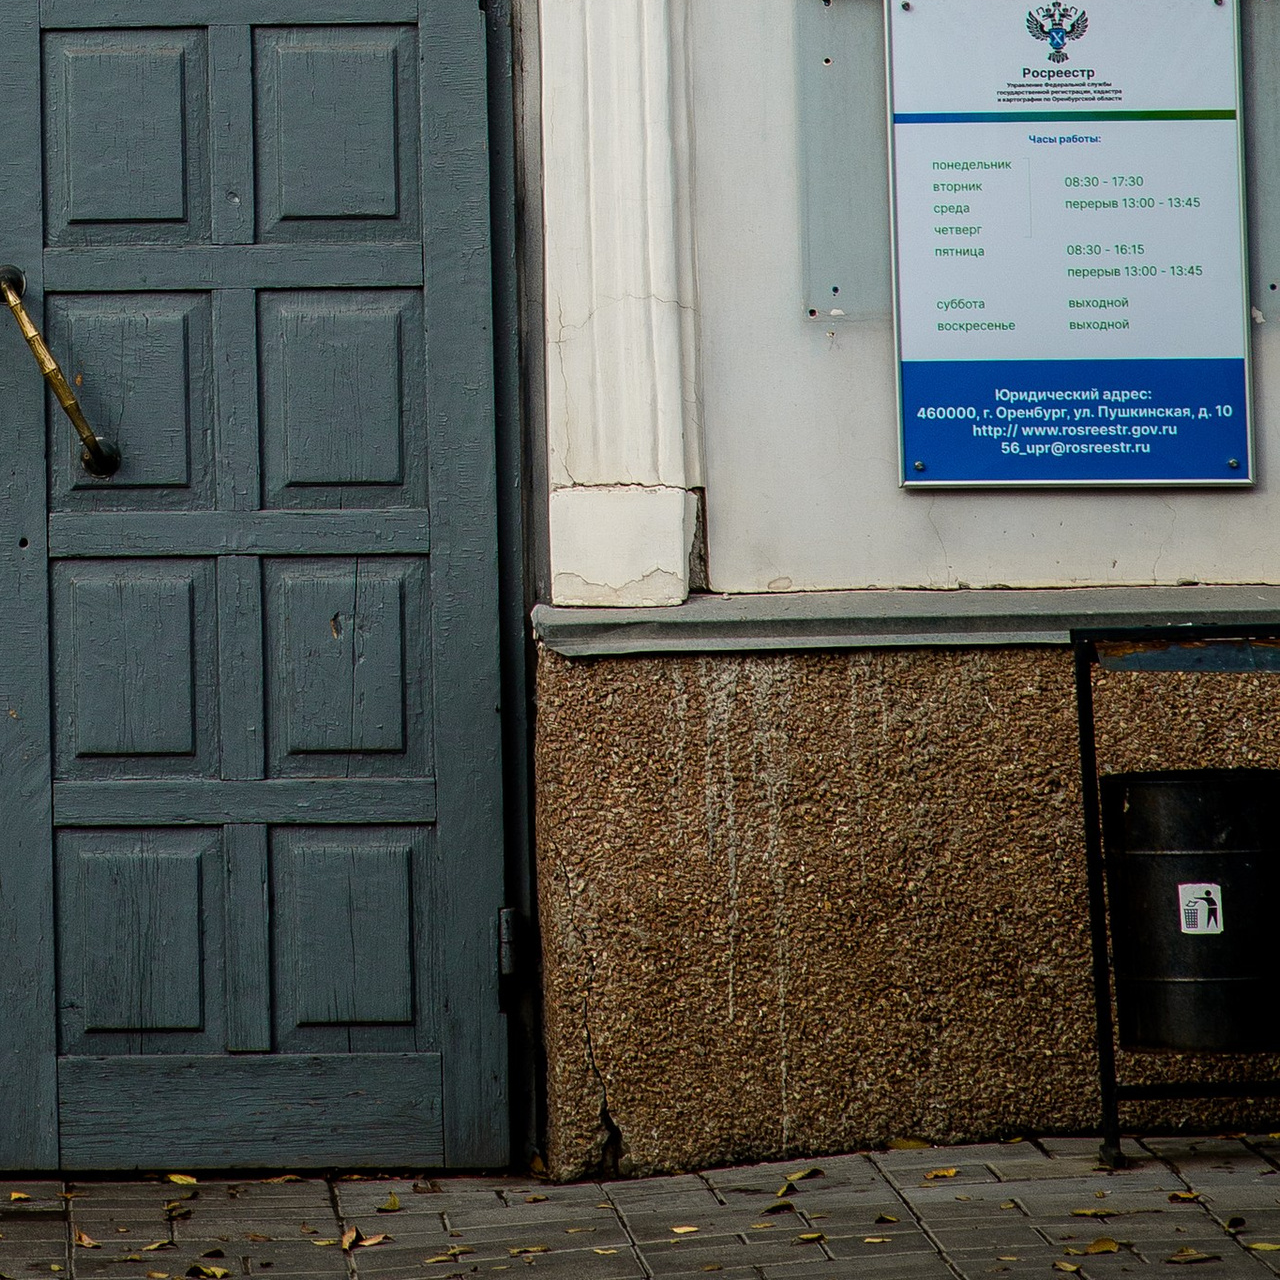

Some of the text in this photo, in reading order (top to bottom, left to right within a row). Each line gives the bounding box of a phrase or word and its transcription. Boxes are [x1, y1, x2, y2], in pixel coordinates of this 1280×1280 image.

[1022, 67, 1095, 80] Росреестр
[1029, 134, 1101, 145] Часы работы:
[932, 158, 1012, 172] понедельник
[933, 182, 983, 194] вторник
[1065, 176, 1099, 188] 08:30
[1112, 175, 1144, 187] 17:30
[933, 204, 970, 215] среда
[1065, 199, 1118, 211] перерыв
[1122, 197, 1155, 209] 13:00
[1168, 196, 1201, 209] 13:45
[934, 225, 982, 237] четверг
[935, 247, 985, 259] пятница
[1067, 244, 1102, 256] 08:30
[1114, 243, 1145, 255] 16:15
[1067, 267, 1121, 280] перерыв
[1125, 265, 1158, 277] 13:00
[1170, 265, 1203, 277] 13:45
[937, 298, 986, 312] суббота
[1069, 296, 1129, 310] выходной
[937, 321, 1016, 333] воскресенье
[1070, 318, 1130, 332] выходной
[995, 387, 1152, 403] Юридический адрес:
[917, 404, 1233, 421] 460000, г. Оренбург, ул. Пушкинская, д. 10
[1022, 424, 1178, 438] www.rosreestr.gov.ru
[1001, 441, 1151, 457] 56_upr@rosreestr.ru
